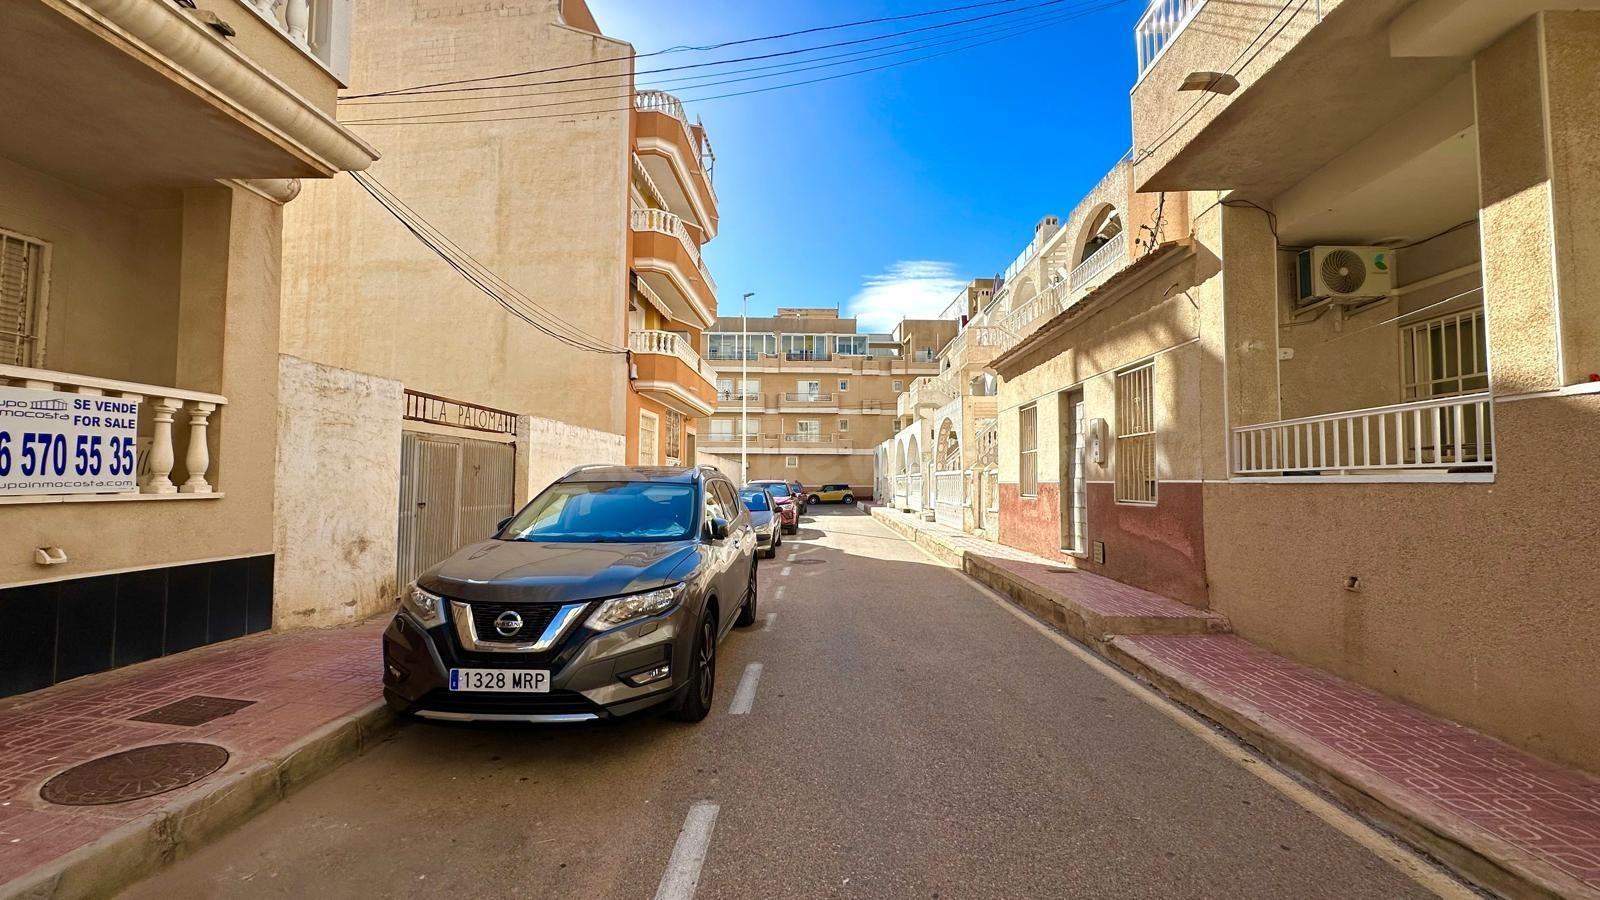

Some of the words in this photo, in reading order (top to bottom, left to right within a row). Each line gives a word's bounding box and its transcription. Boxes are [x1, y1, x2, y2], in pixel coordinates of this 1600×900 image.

[73, 398, 91, 411] SE
[95, 400, 137, 414] VENDE
[73, 415, 101, 427] FOR
[104, 417, 136, 429] SALE
[431, 400, 447, 422] LA
[457, 404, 504, 432] PALOMA
[0, 431, 12, 477] 6
[21, 432, 67, 477] 570
[75, 434, 102, 476] 55
[109, 436, 135, 476] 35
[464, 671, 506, 689] 1328
[512, 672, 545, 689] MRP
